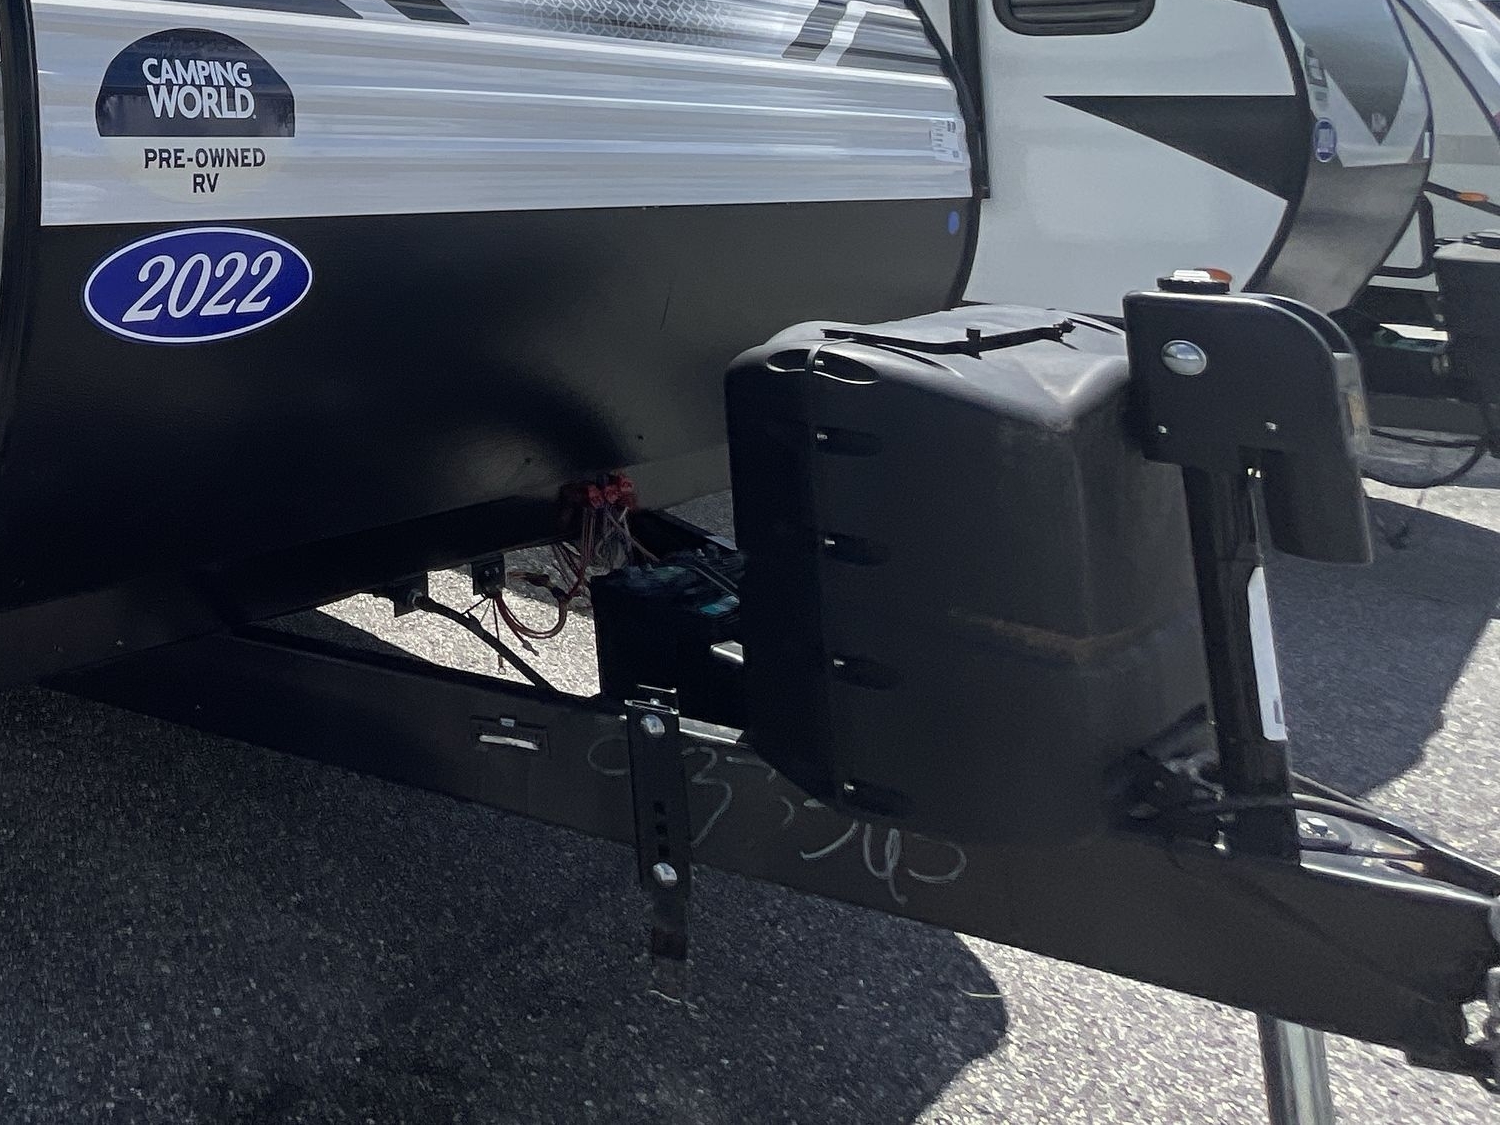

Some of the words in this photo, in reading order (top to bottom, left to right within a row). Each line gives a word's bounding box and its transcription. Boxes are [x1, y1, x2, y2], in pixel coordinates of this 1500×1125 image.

[142, 58, 252, 87] CAMPING
[144, 147, 266, 169] PRE-OWNED
[193, 173, 219, 193] RV
[122, 250, 283, 323] 2022
